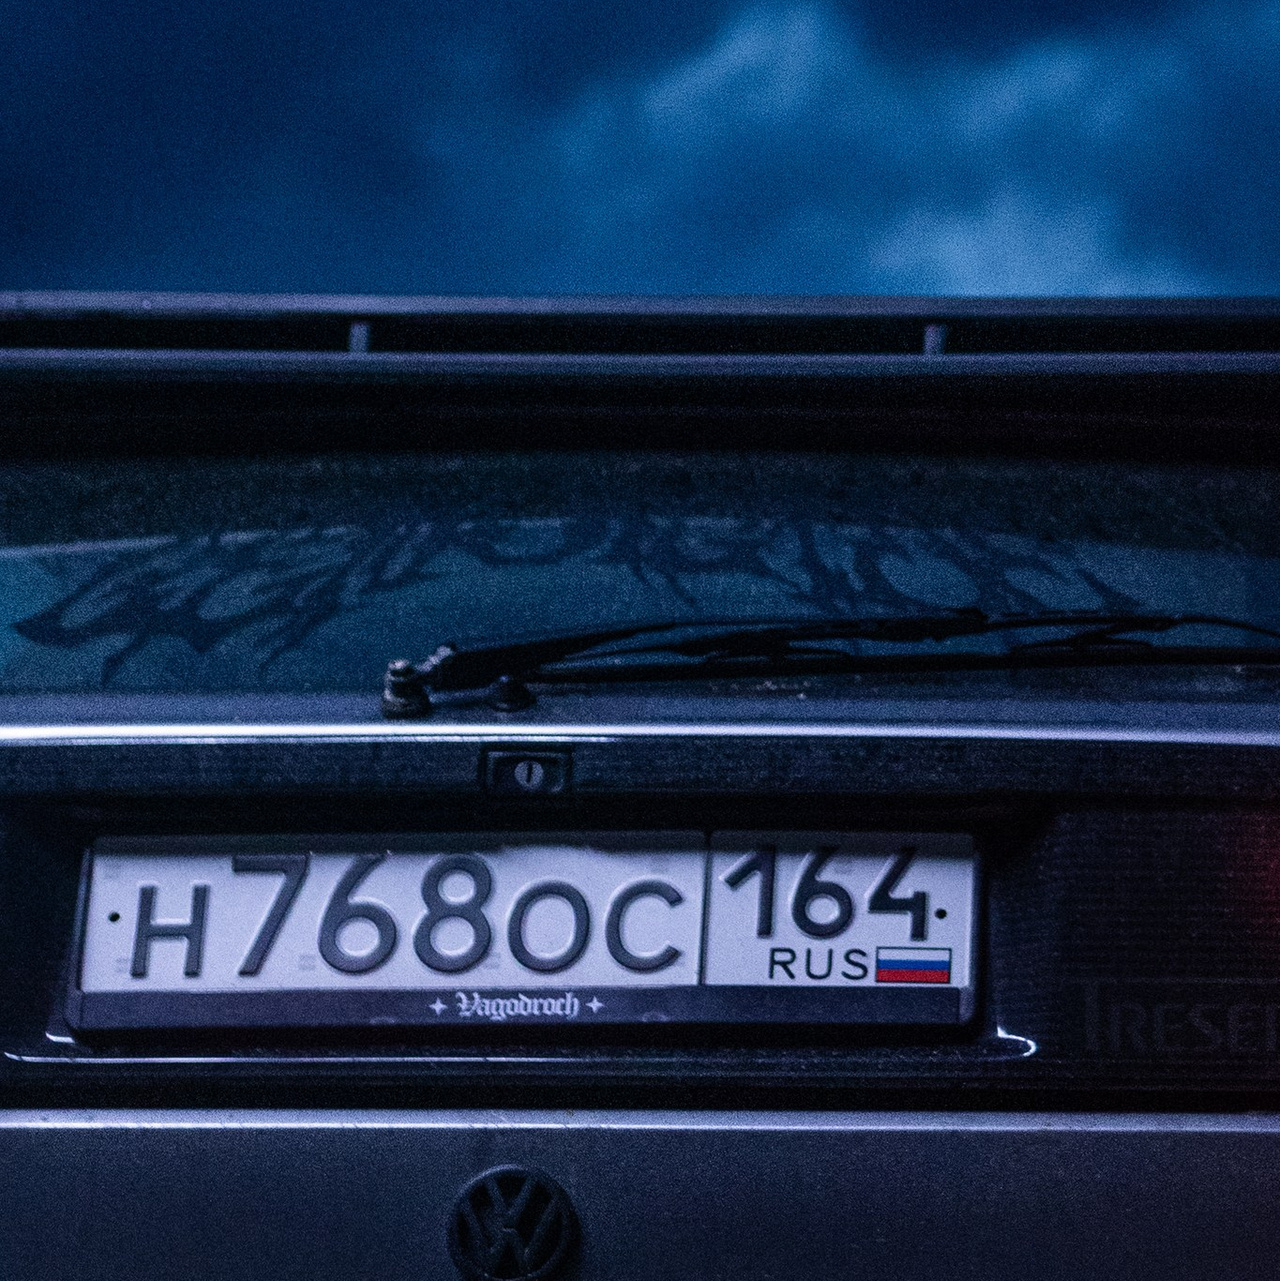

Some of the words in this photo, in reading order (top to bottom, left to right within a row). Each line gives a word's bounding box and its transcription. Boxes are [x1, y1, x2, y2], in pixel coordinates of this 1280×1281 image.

[130, 853, 684, 978] H768OC
[722, 843, 928, 942] 164
[769, 948, 869, 981] RUS
